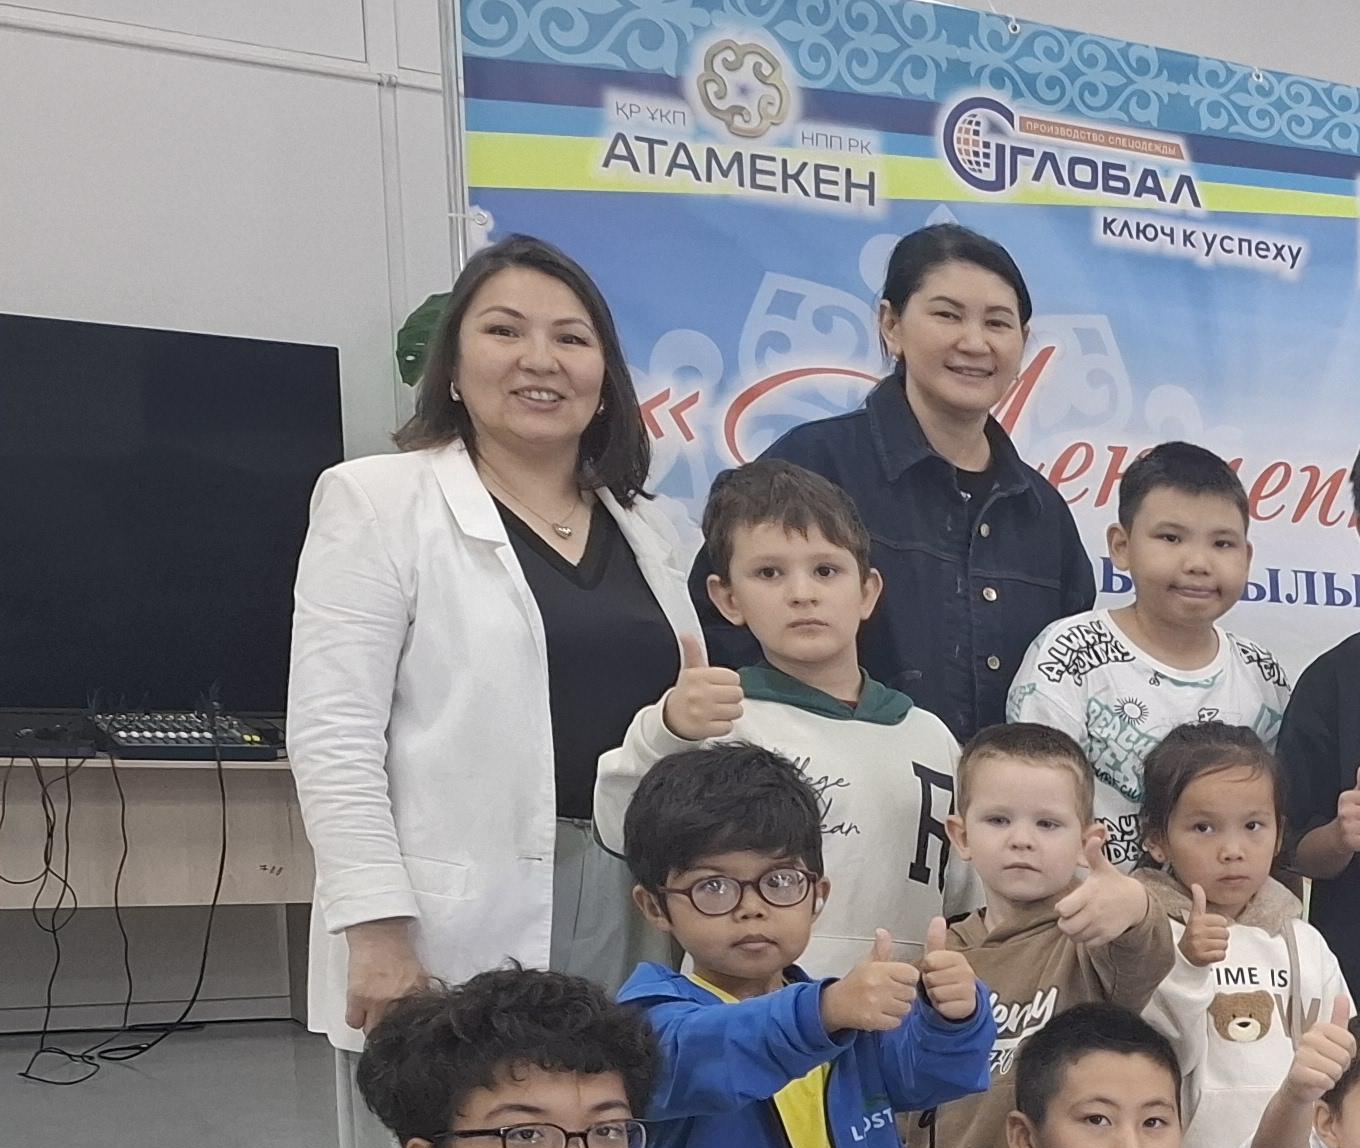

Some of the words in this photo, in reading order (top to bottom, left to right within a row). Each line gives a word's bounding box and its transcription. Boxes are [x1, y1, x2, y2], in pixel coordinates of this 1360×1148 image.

[801, 131, 842, 151] НПП
[848, 137, 872, 155] РК
[1025, 121, 1106, 144] ПРОИЗВОДСТВО
[1108, 134, 1177, 156] СПЕЦОДЕЖДЫ
[601, 131, 876, 207] АТАМЕКЕН
[1211, 967, 1260, 986] IME
[1271, 969, 1288, 987] IS
